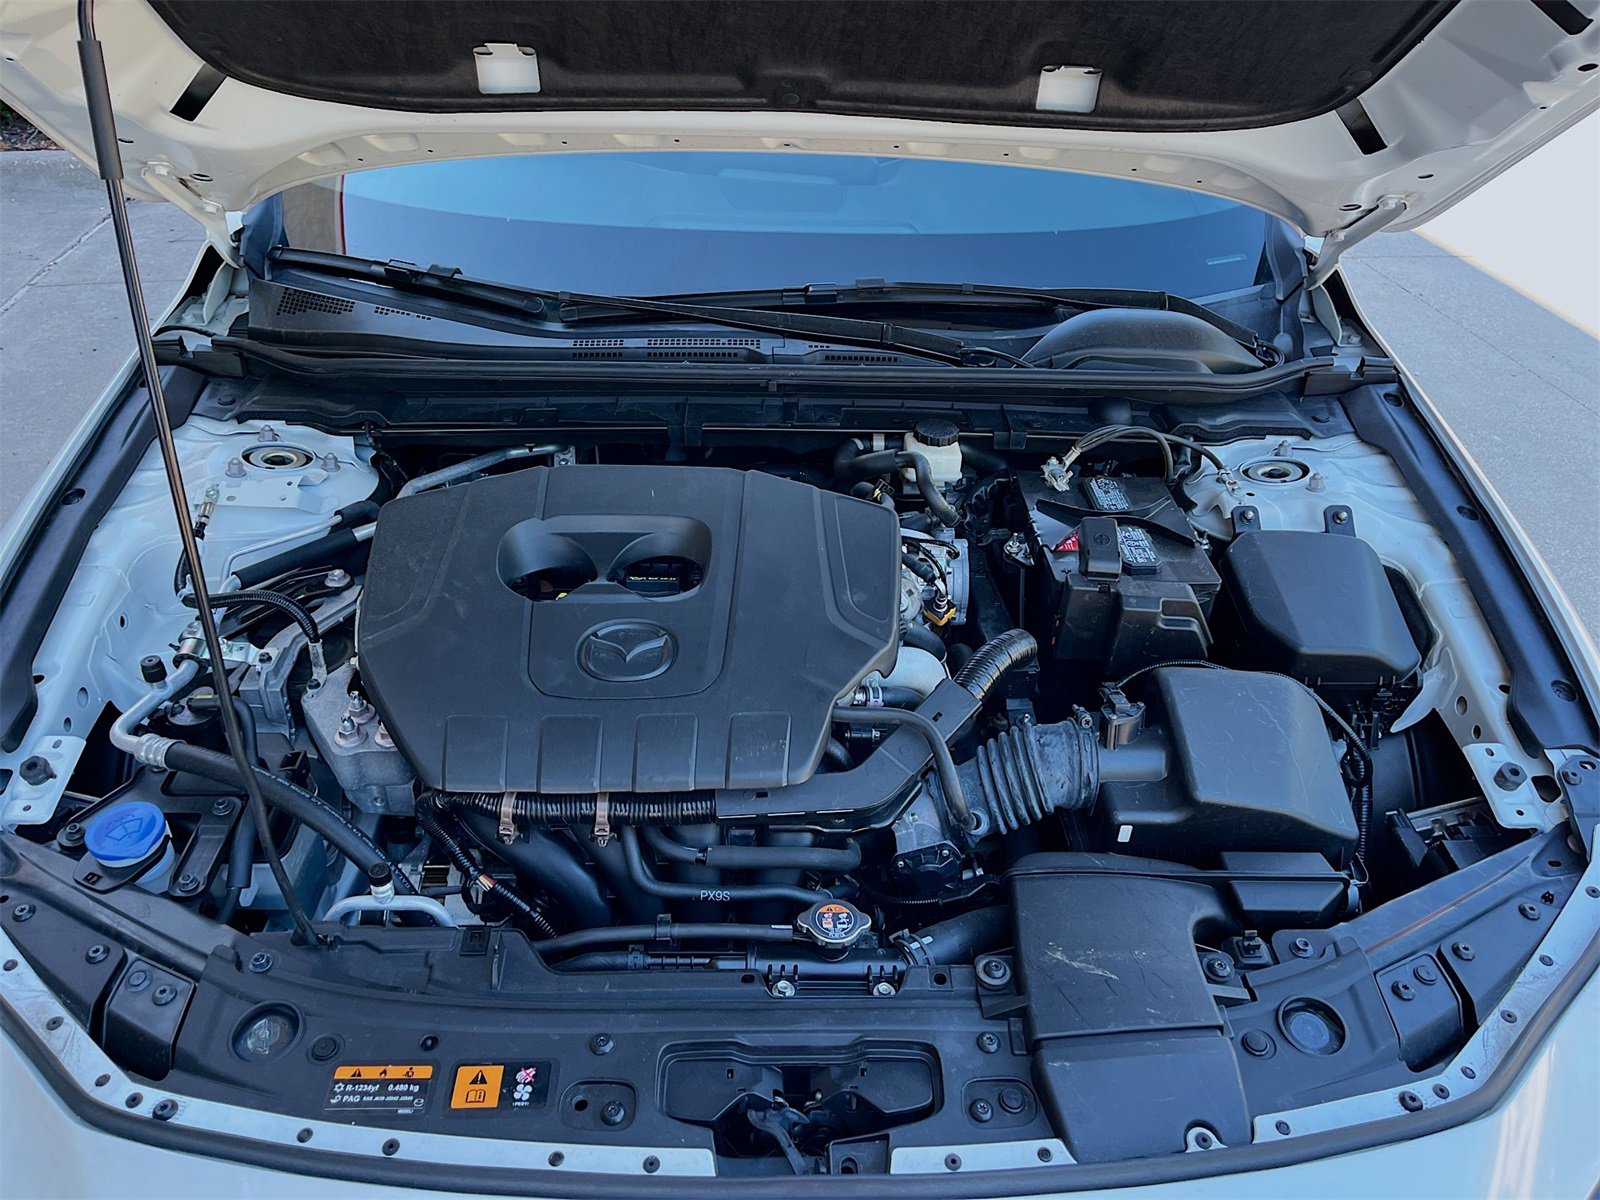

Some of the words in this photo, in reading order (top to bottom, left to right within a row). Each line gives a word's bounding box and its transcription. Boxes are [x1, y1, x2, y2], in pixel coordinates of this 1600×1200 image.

[385, 861, 411, 888] GALAXY
[700, 890, 730, 901] PX9S
[345, 1083, 380, 1093] R-1234yf
[409, 1083, 420, 1092] kg
[342, 1094, 361, 1103] PAG
